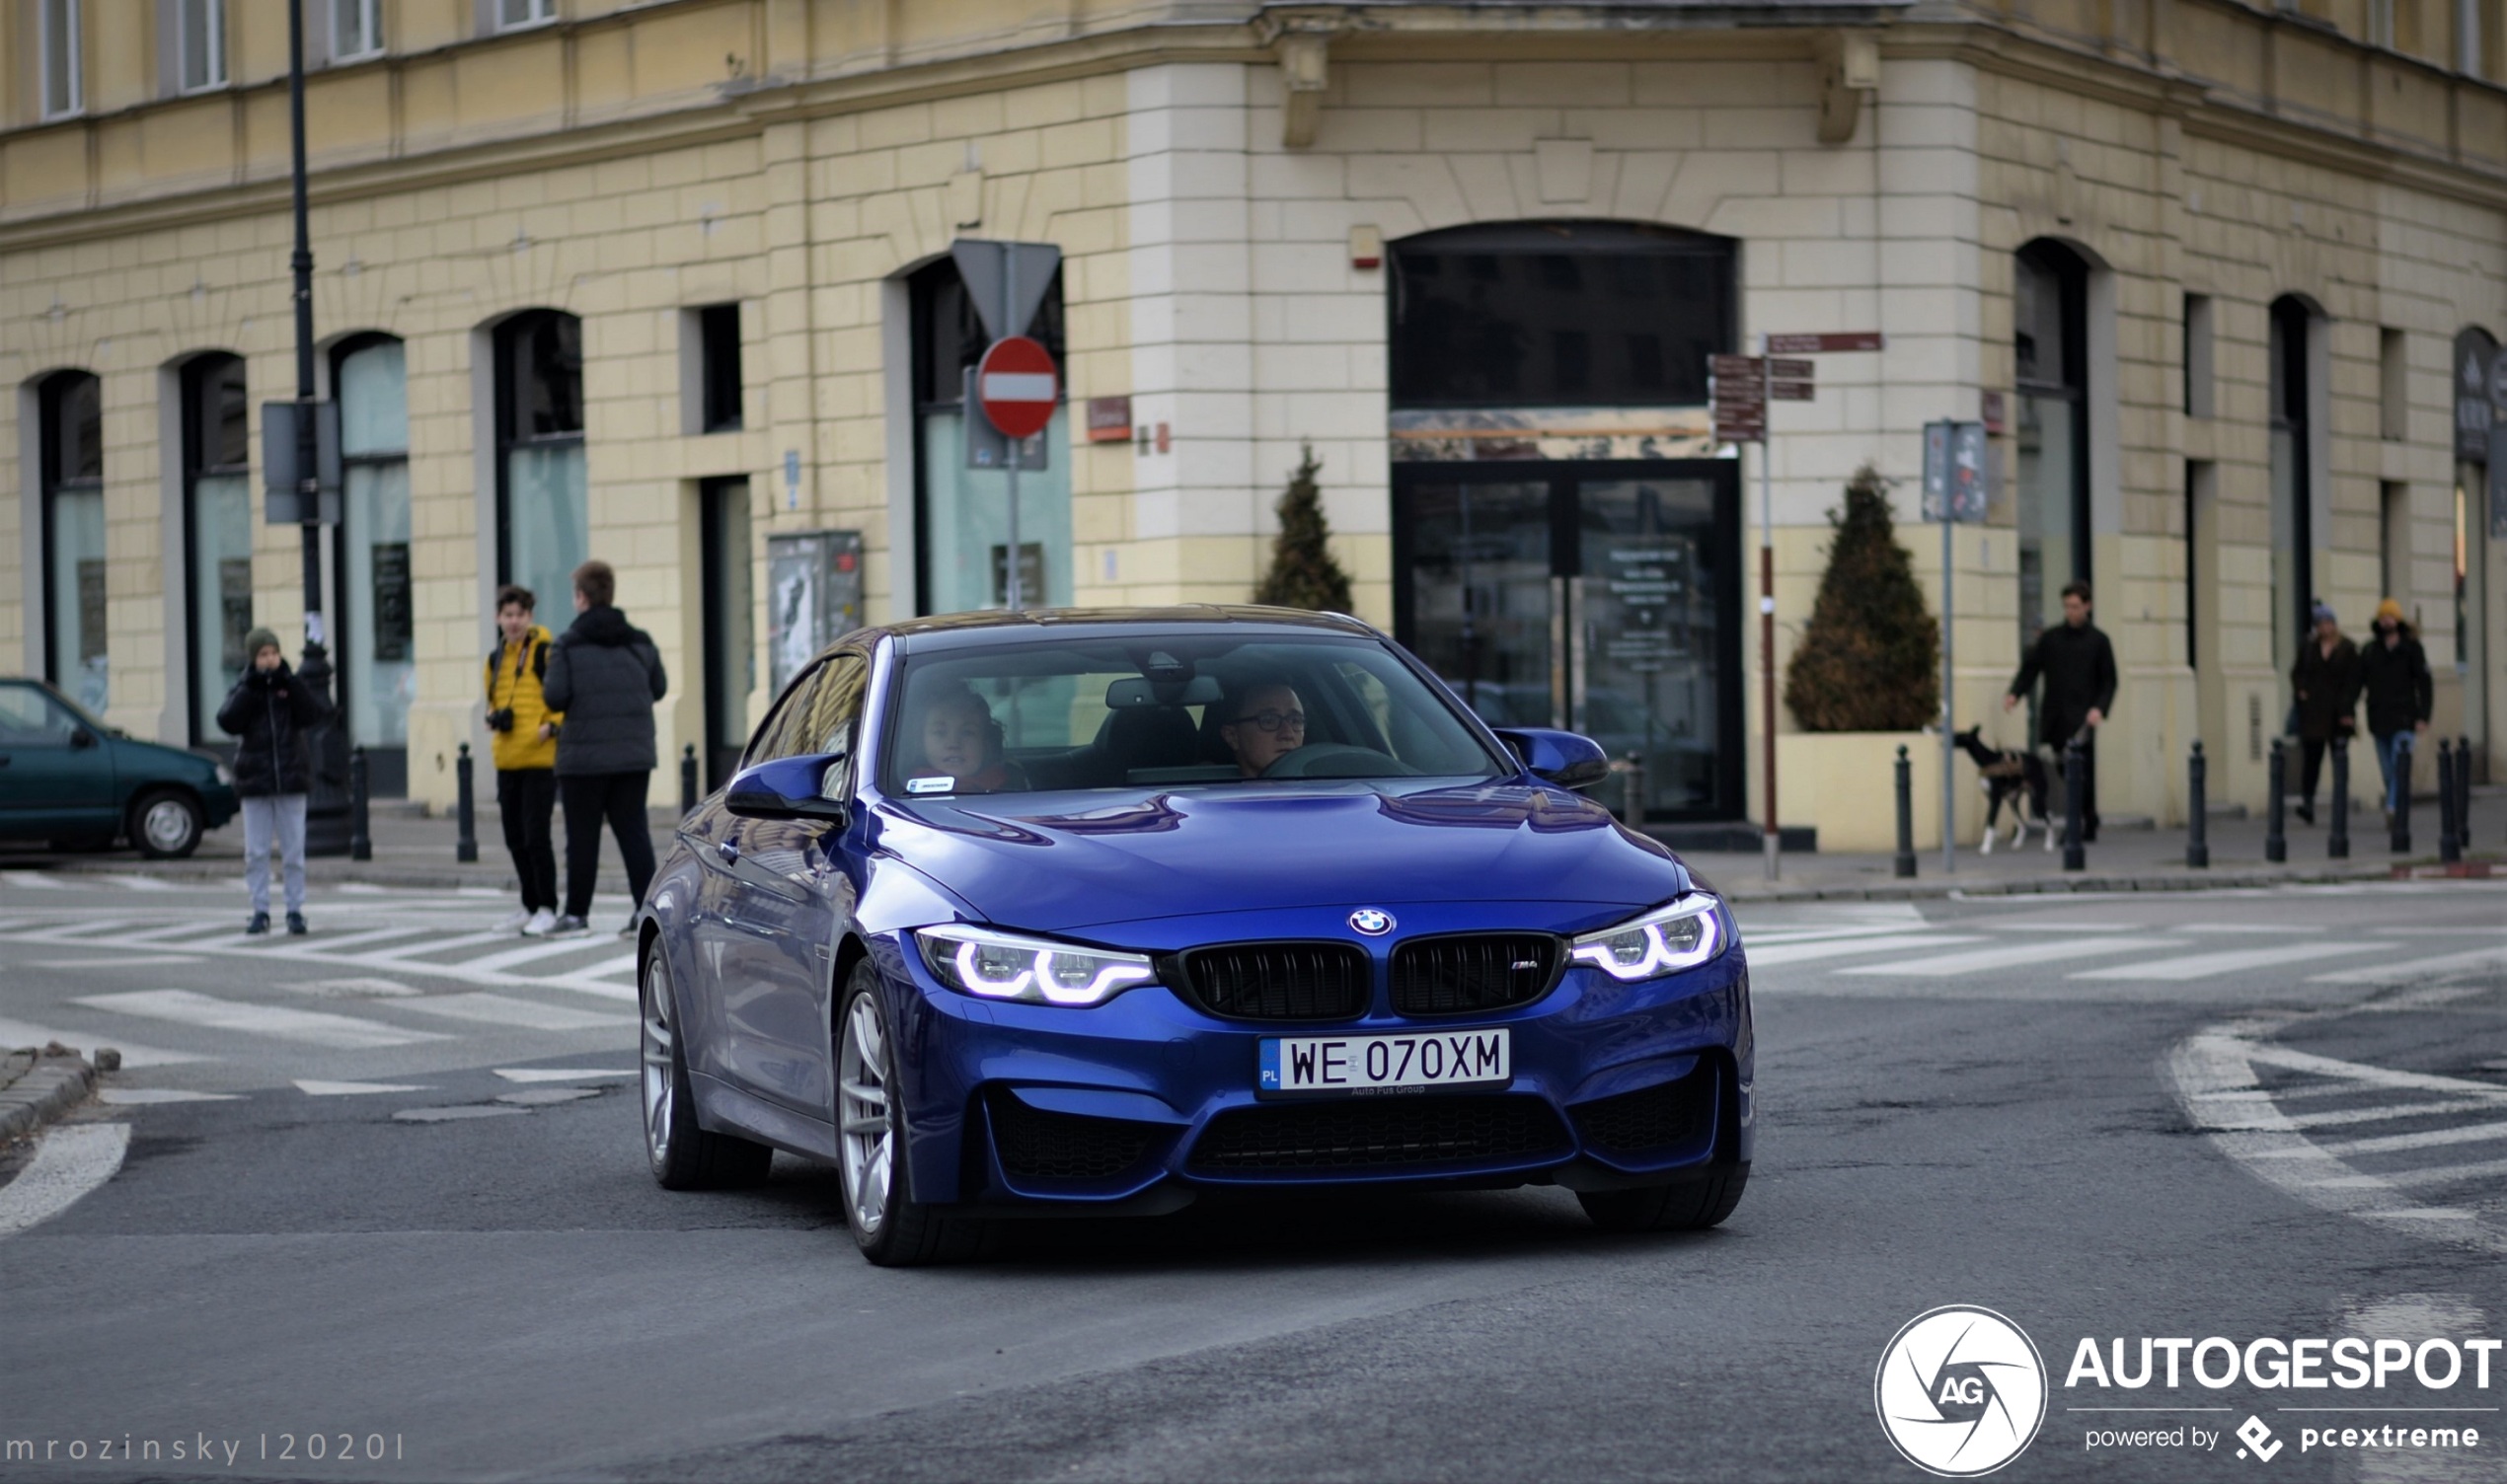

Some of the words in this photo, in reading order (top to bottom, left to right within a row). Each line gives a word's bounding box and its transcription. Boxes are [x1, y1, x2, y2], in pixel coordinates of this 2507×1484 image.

[1513, 960, 1538, 970] M4
[1291, 1042, 1347, 1084] WE
[1366, 1034, 1500, 1081] 070XM
[1262, 1071, 1278, 1082] PL
[1351, 1086, 1375, 1096] Auto
[1377, 1085, 1395, 1095] Fus
[1396, 1084, 1425, 1095] Group
